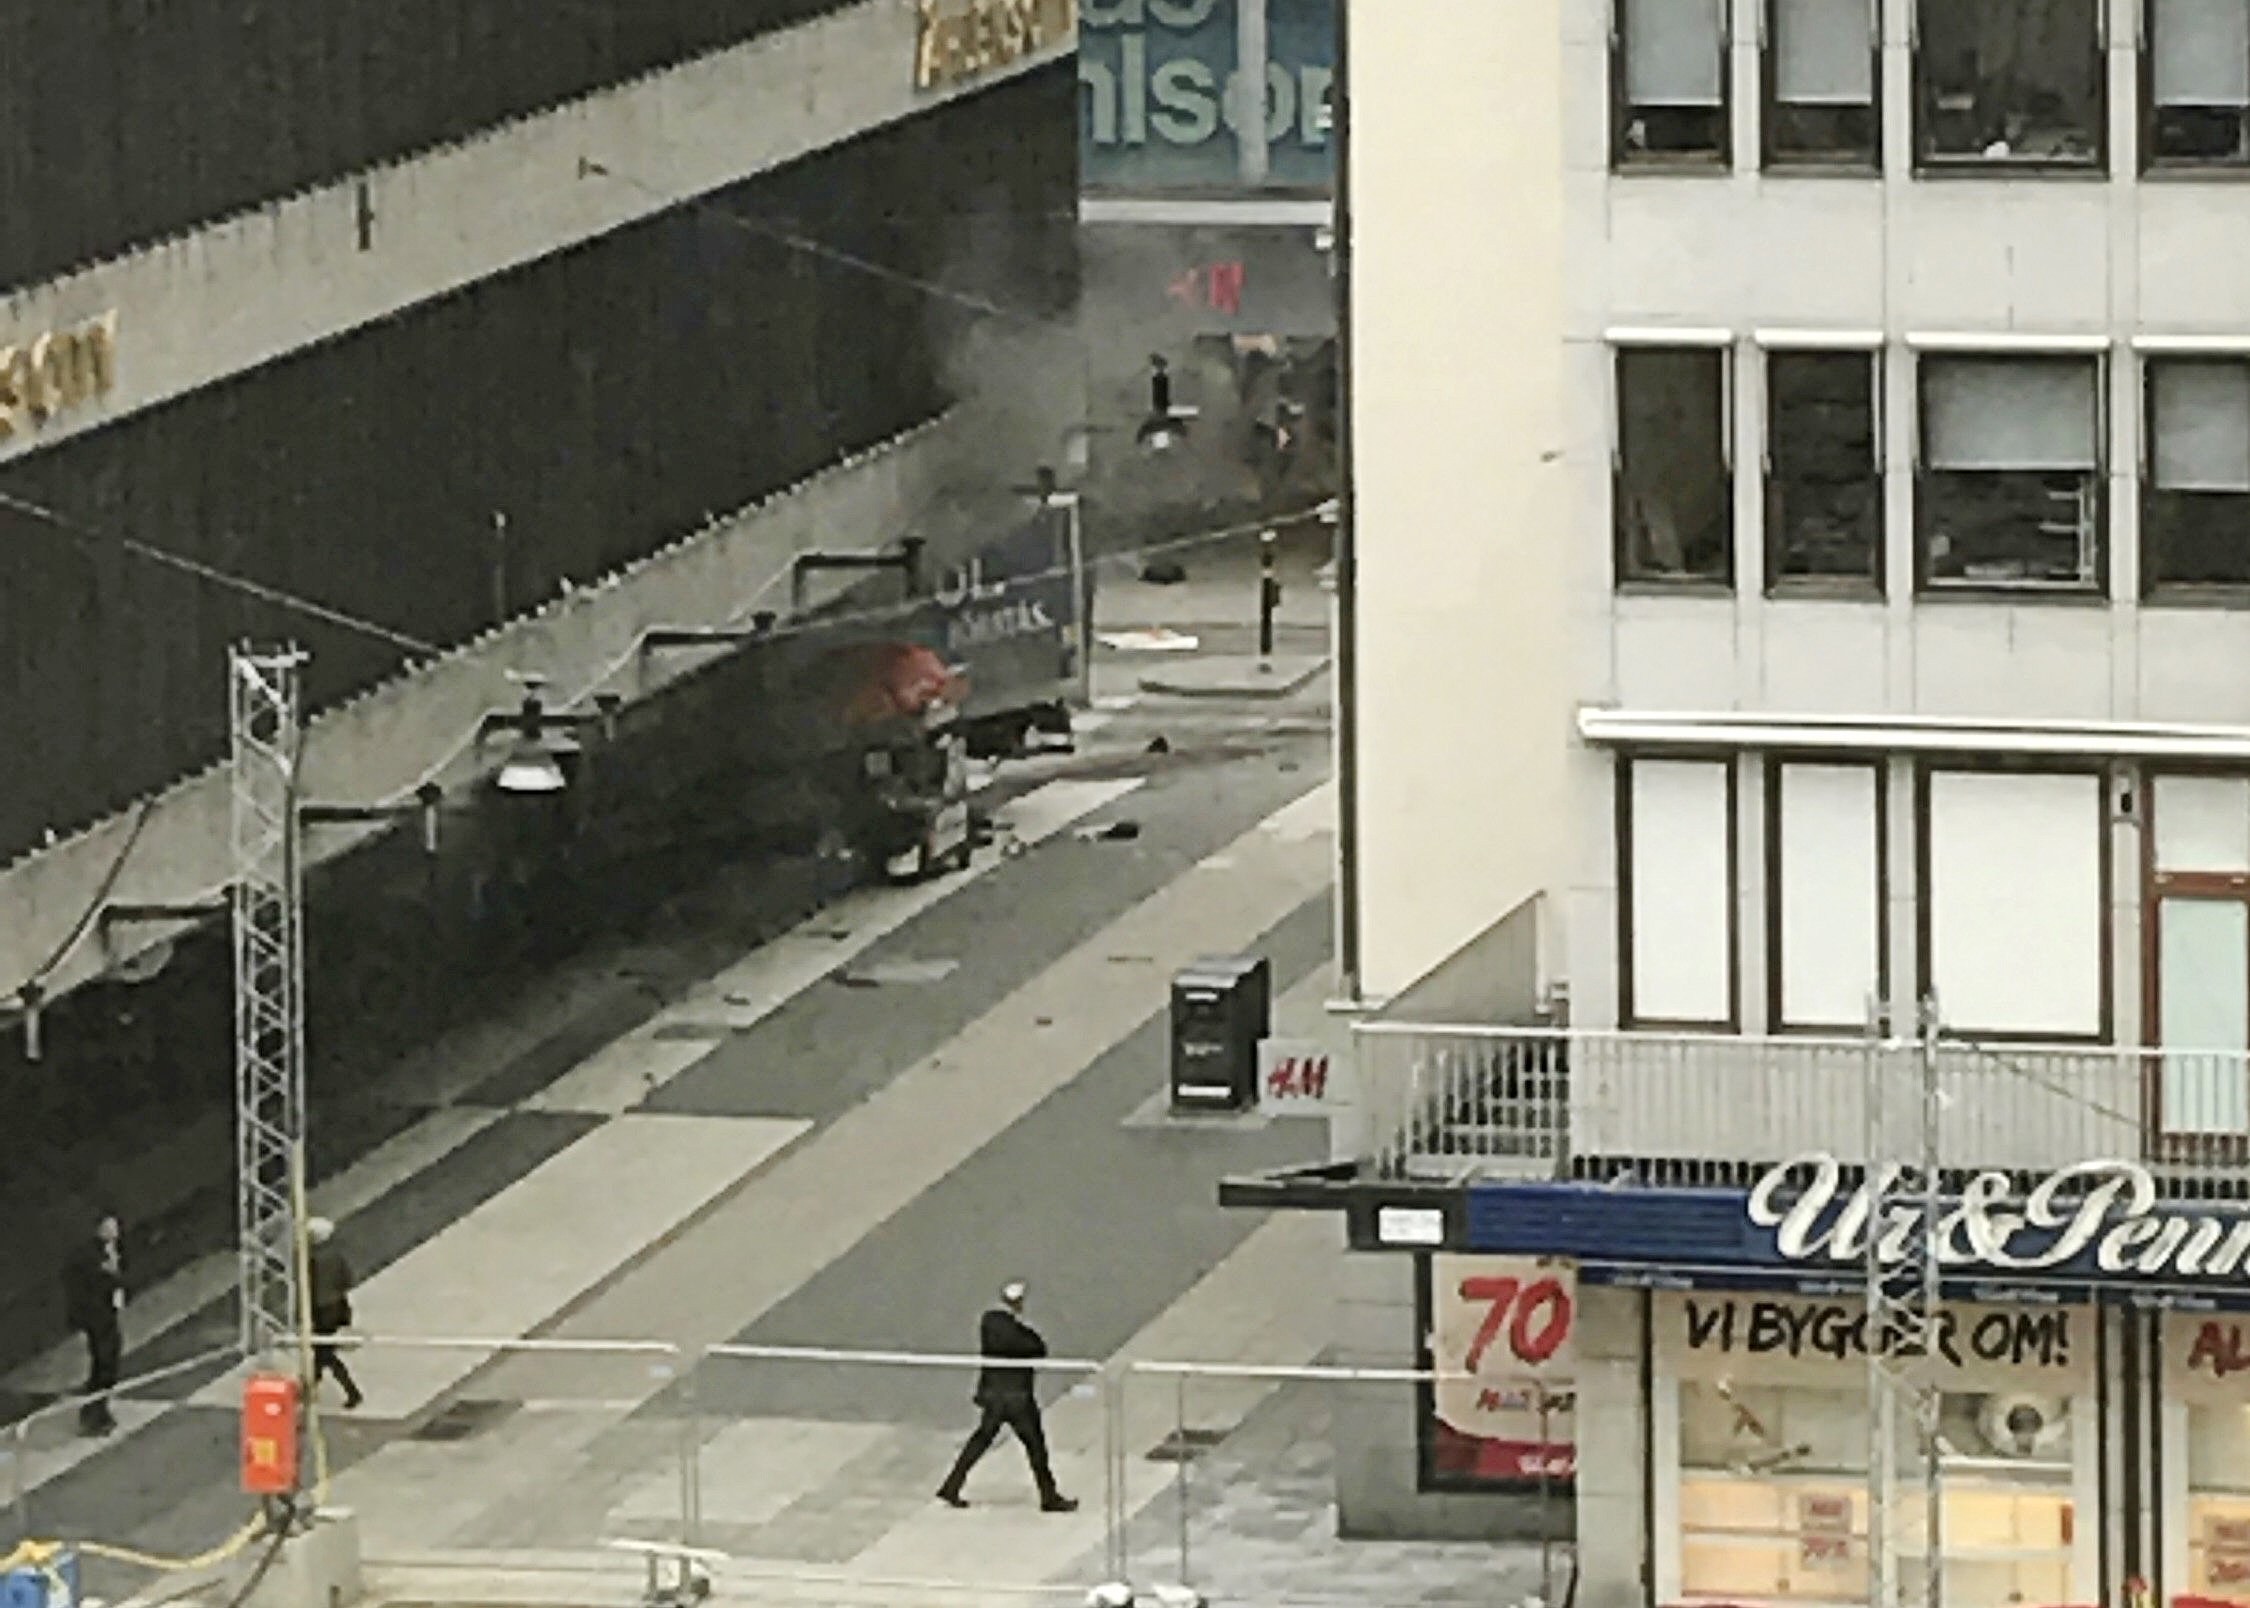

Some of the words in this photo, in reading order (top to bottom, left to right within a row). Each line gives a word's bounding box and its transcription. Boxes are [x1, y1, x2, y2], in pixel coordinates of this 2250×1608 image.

[1459, 1276, 1571, 1374] 70
[1684, 1300, 1734, 1352] VI
[1972, 1310, 2069, 1367] OM!
